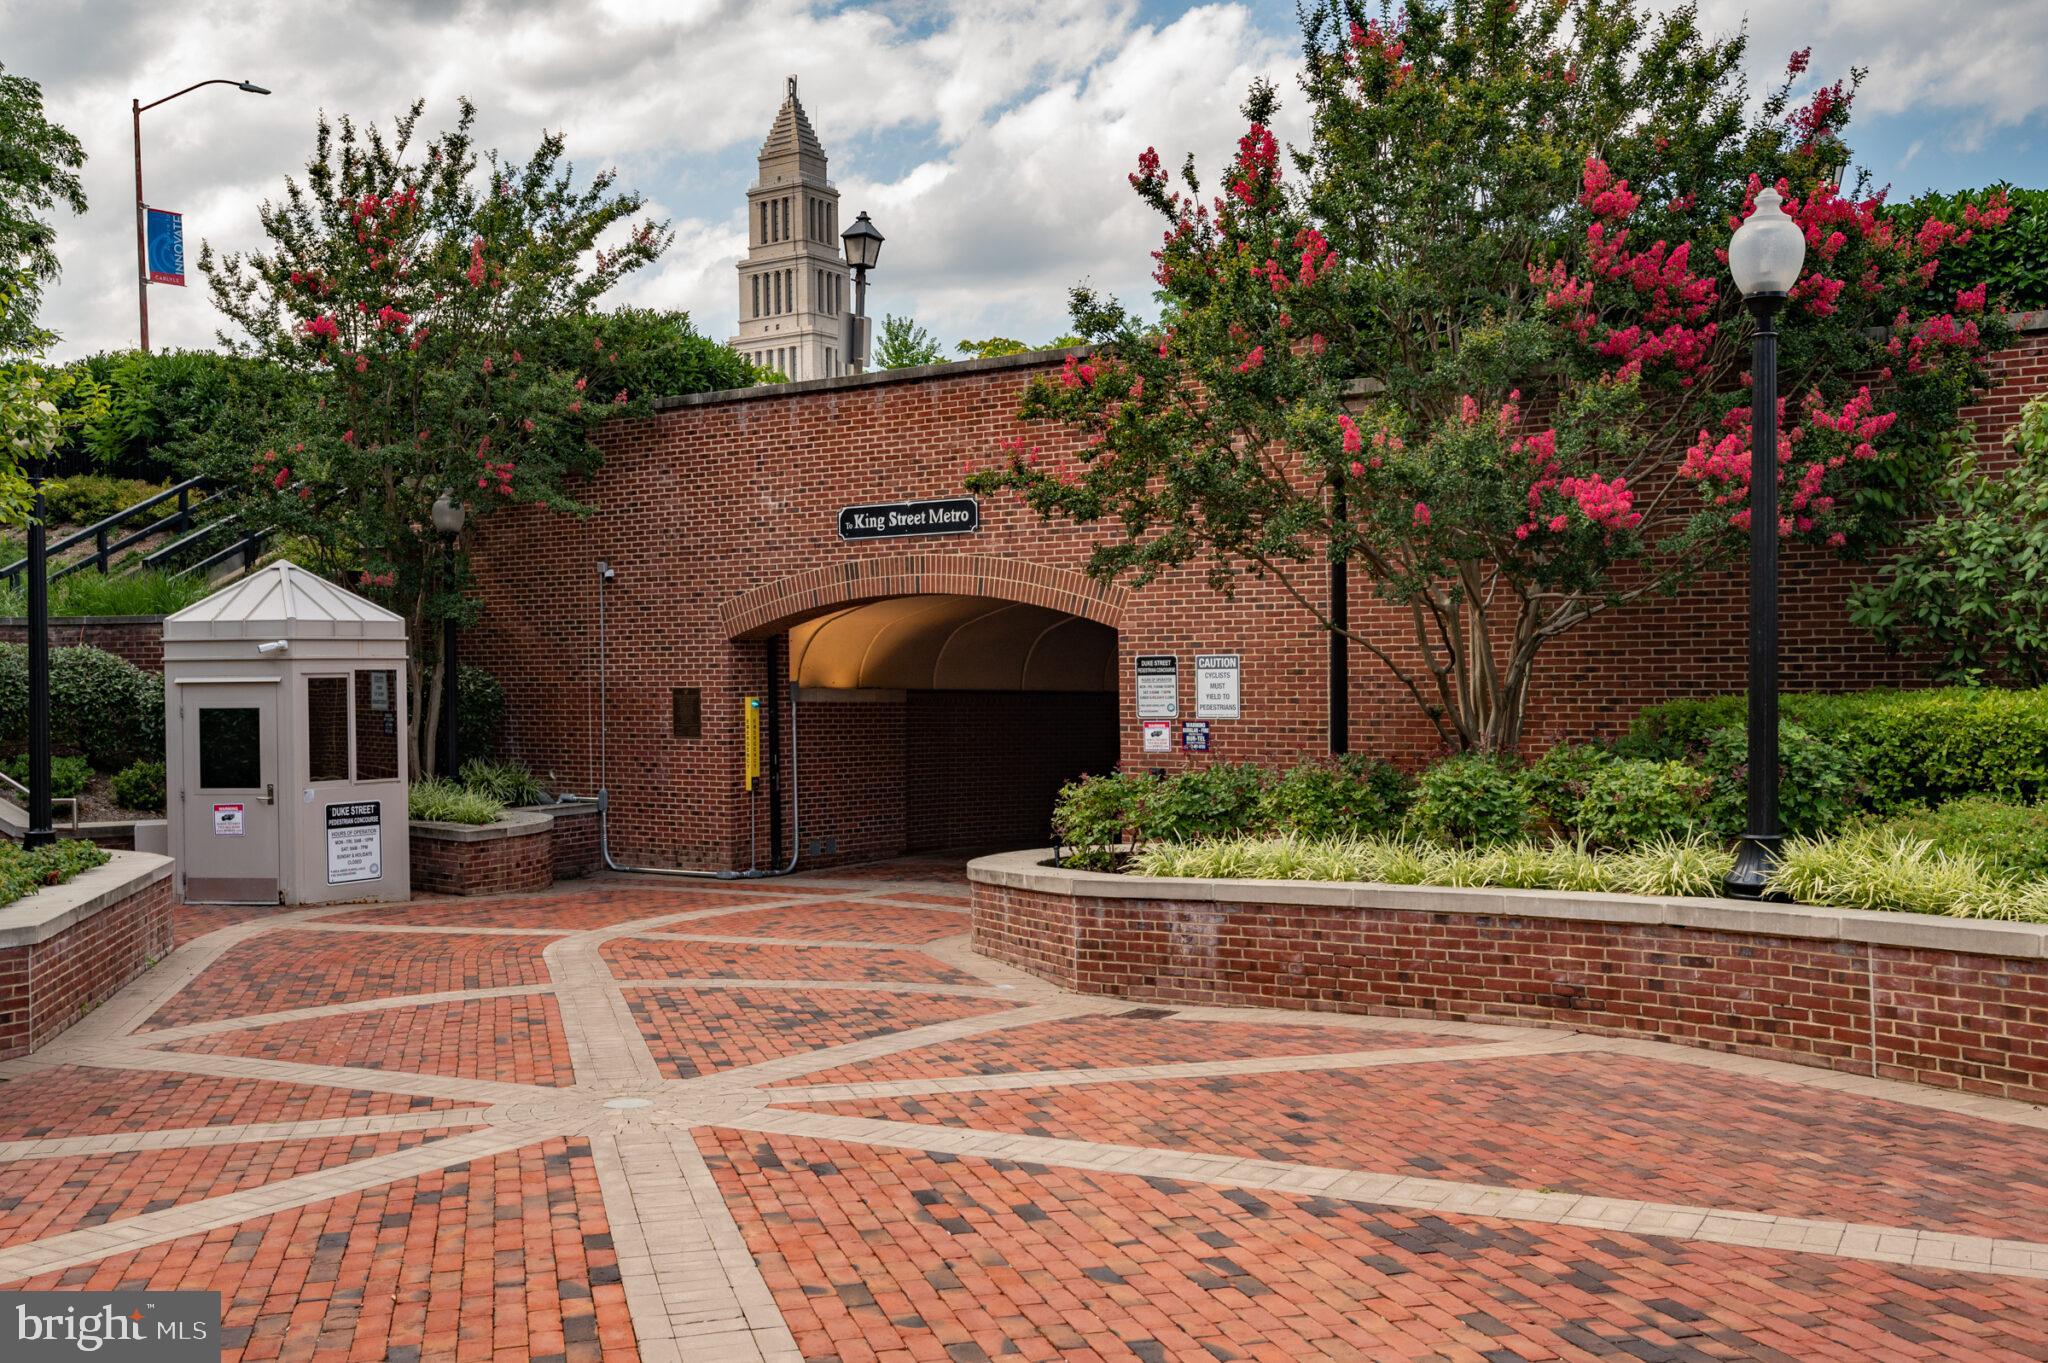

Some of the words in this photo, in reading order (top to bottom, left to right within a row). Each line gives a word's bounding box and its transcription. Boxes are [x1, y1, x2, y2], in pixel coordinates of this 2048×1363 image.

[173, 215, 184, 275] INNOVATE
[154, 274, 180, 283] CARLYLE
[845, 522, 853, 530] To
[854, 513, 886, 531] King
[889, 511, 926, 527] Street
[929, 508, 969, 524] Metro
[1199, 658, 1236, 668] CAUTION
[332, 807, 350, 817] DUKE
[351, 805, 374, 815] STREET
